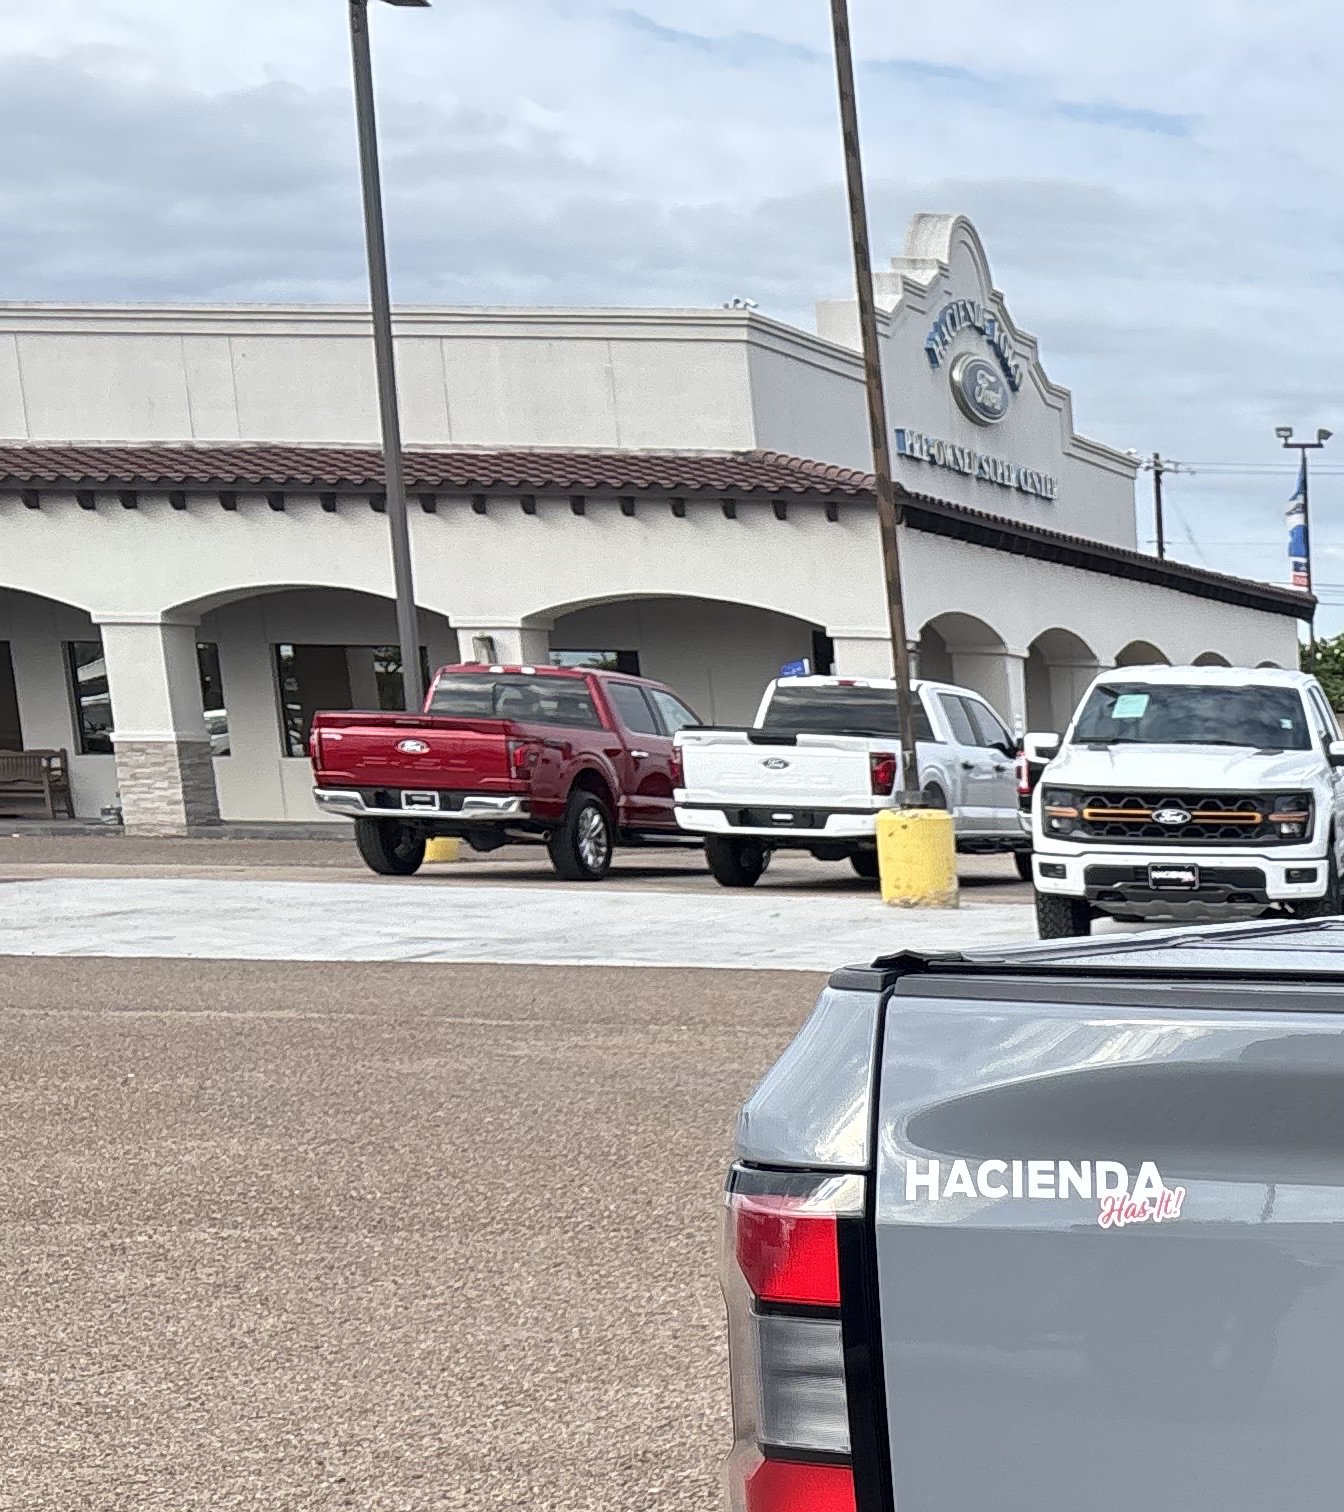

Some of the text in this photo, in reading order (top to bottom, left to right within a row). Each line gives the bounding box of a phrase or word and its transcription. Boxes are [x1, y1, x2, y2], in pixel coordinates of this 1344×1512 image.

[906, 1159, 1164, 1201] HACIENDA
[1101, 1189, 1183, 1225] Has It!
